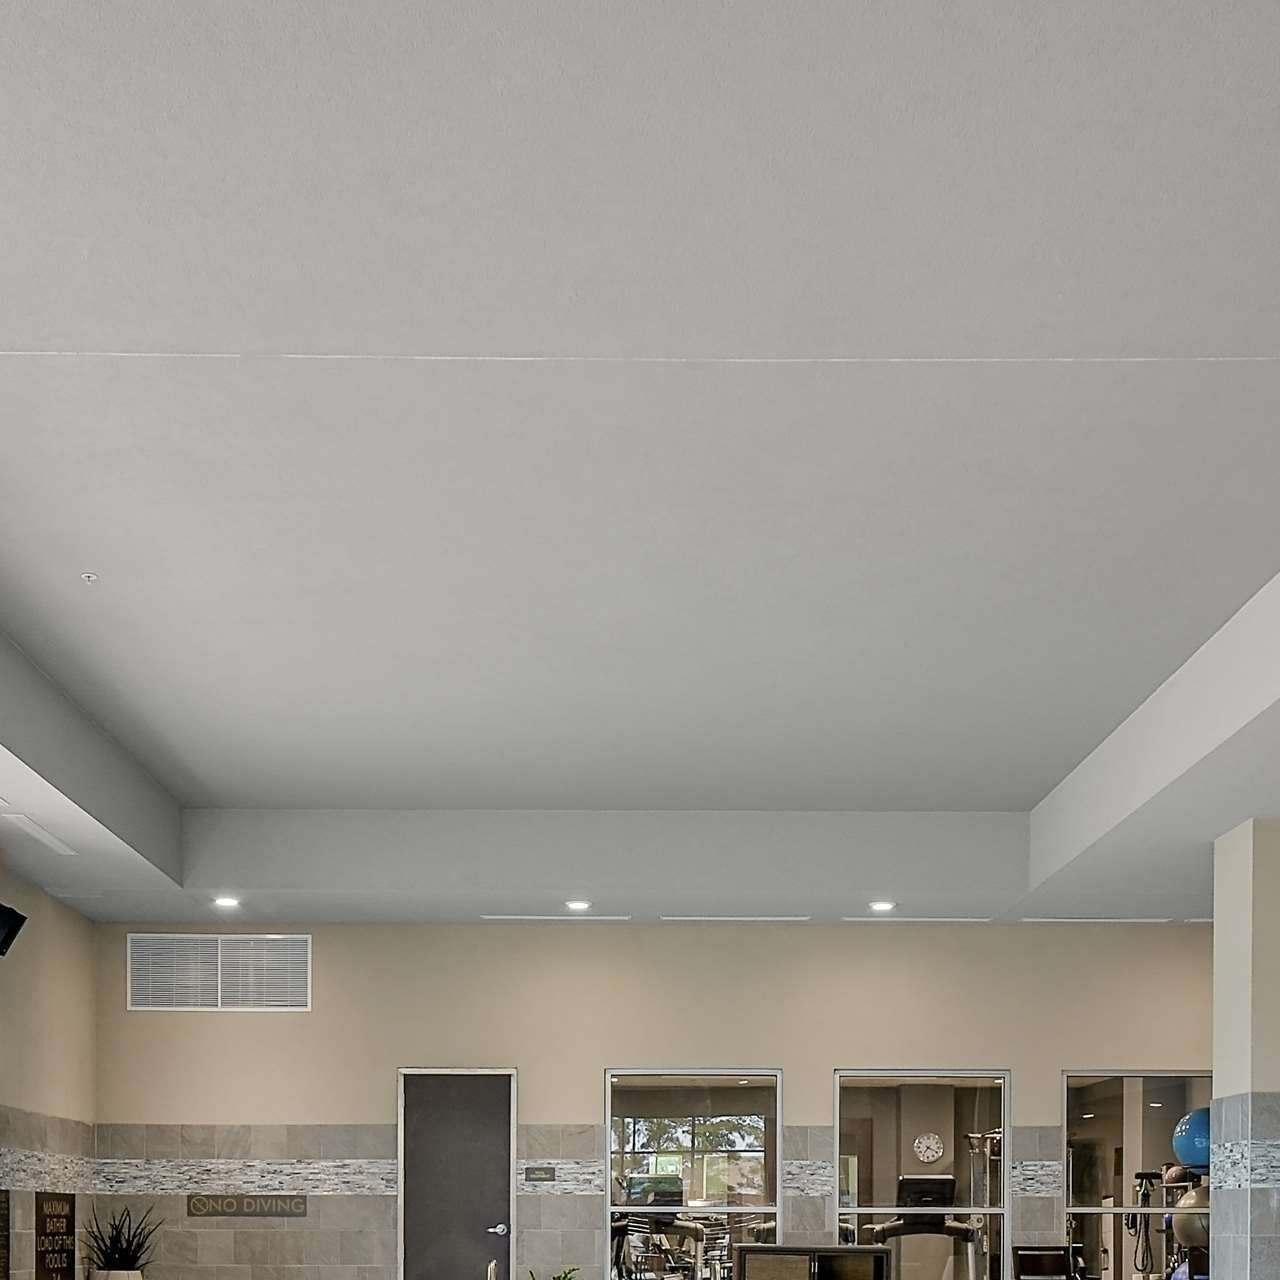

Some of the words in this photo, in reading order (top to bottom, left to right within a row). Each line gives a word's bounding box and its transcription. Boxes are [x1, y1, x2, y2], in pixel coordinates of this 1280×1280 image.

[43, 1200, 69, 1216] MAXIMUM
[209, 1199, 237, 1212] NO
[243, 1198, 305, 1213] DIVING
[37, 1236, 53, 1251] LOAD
